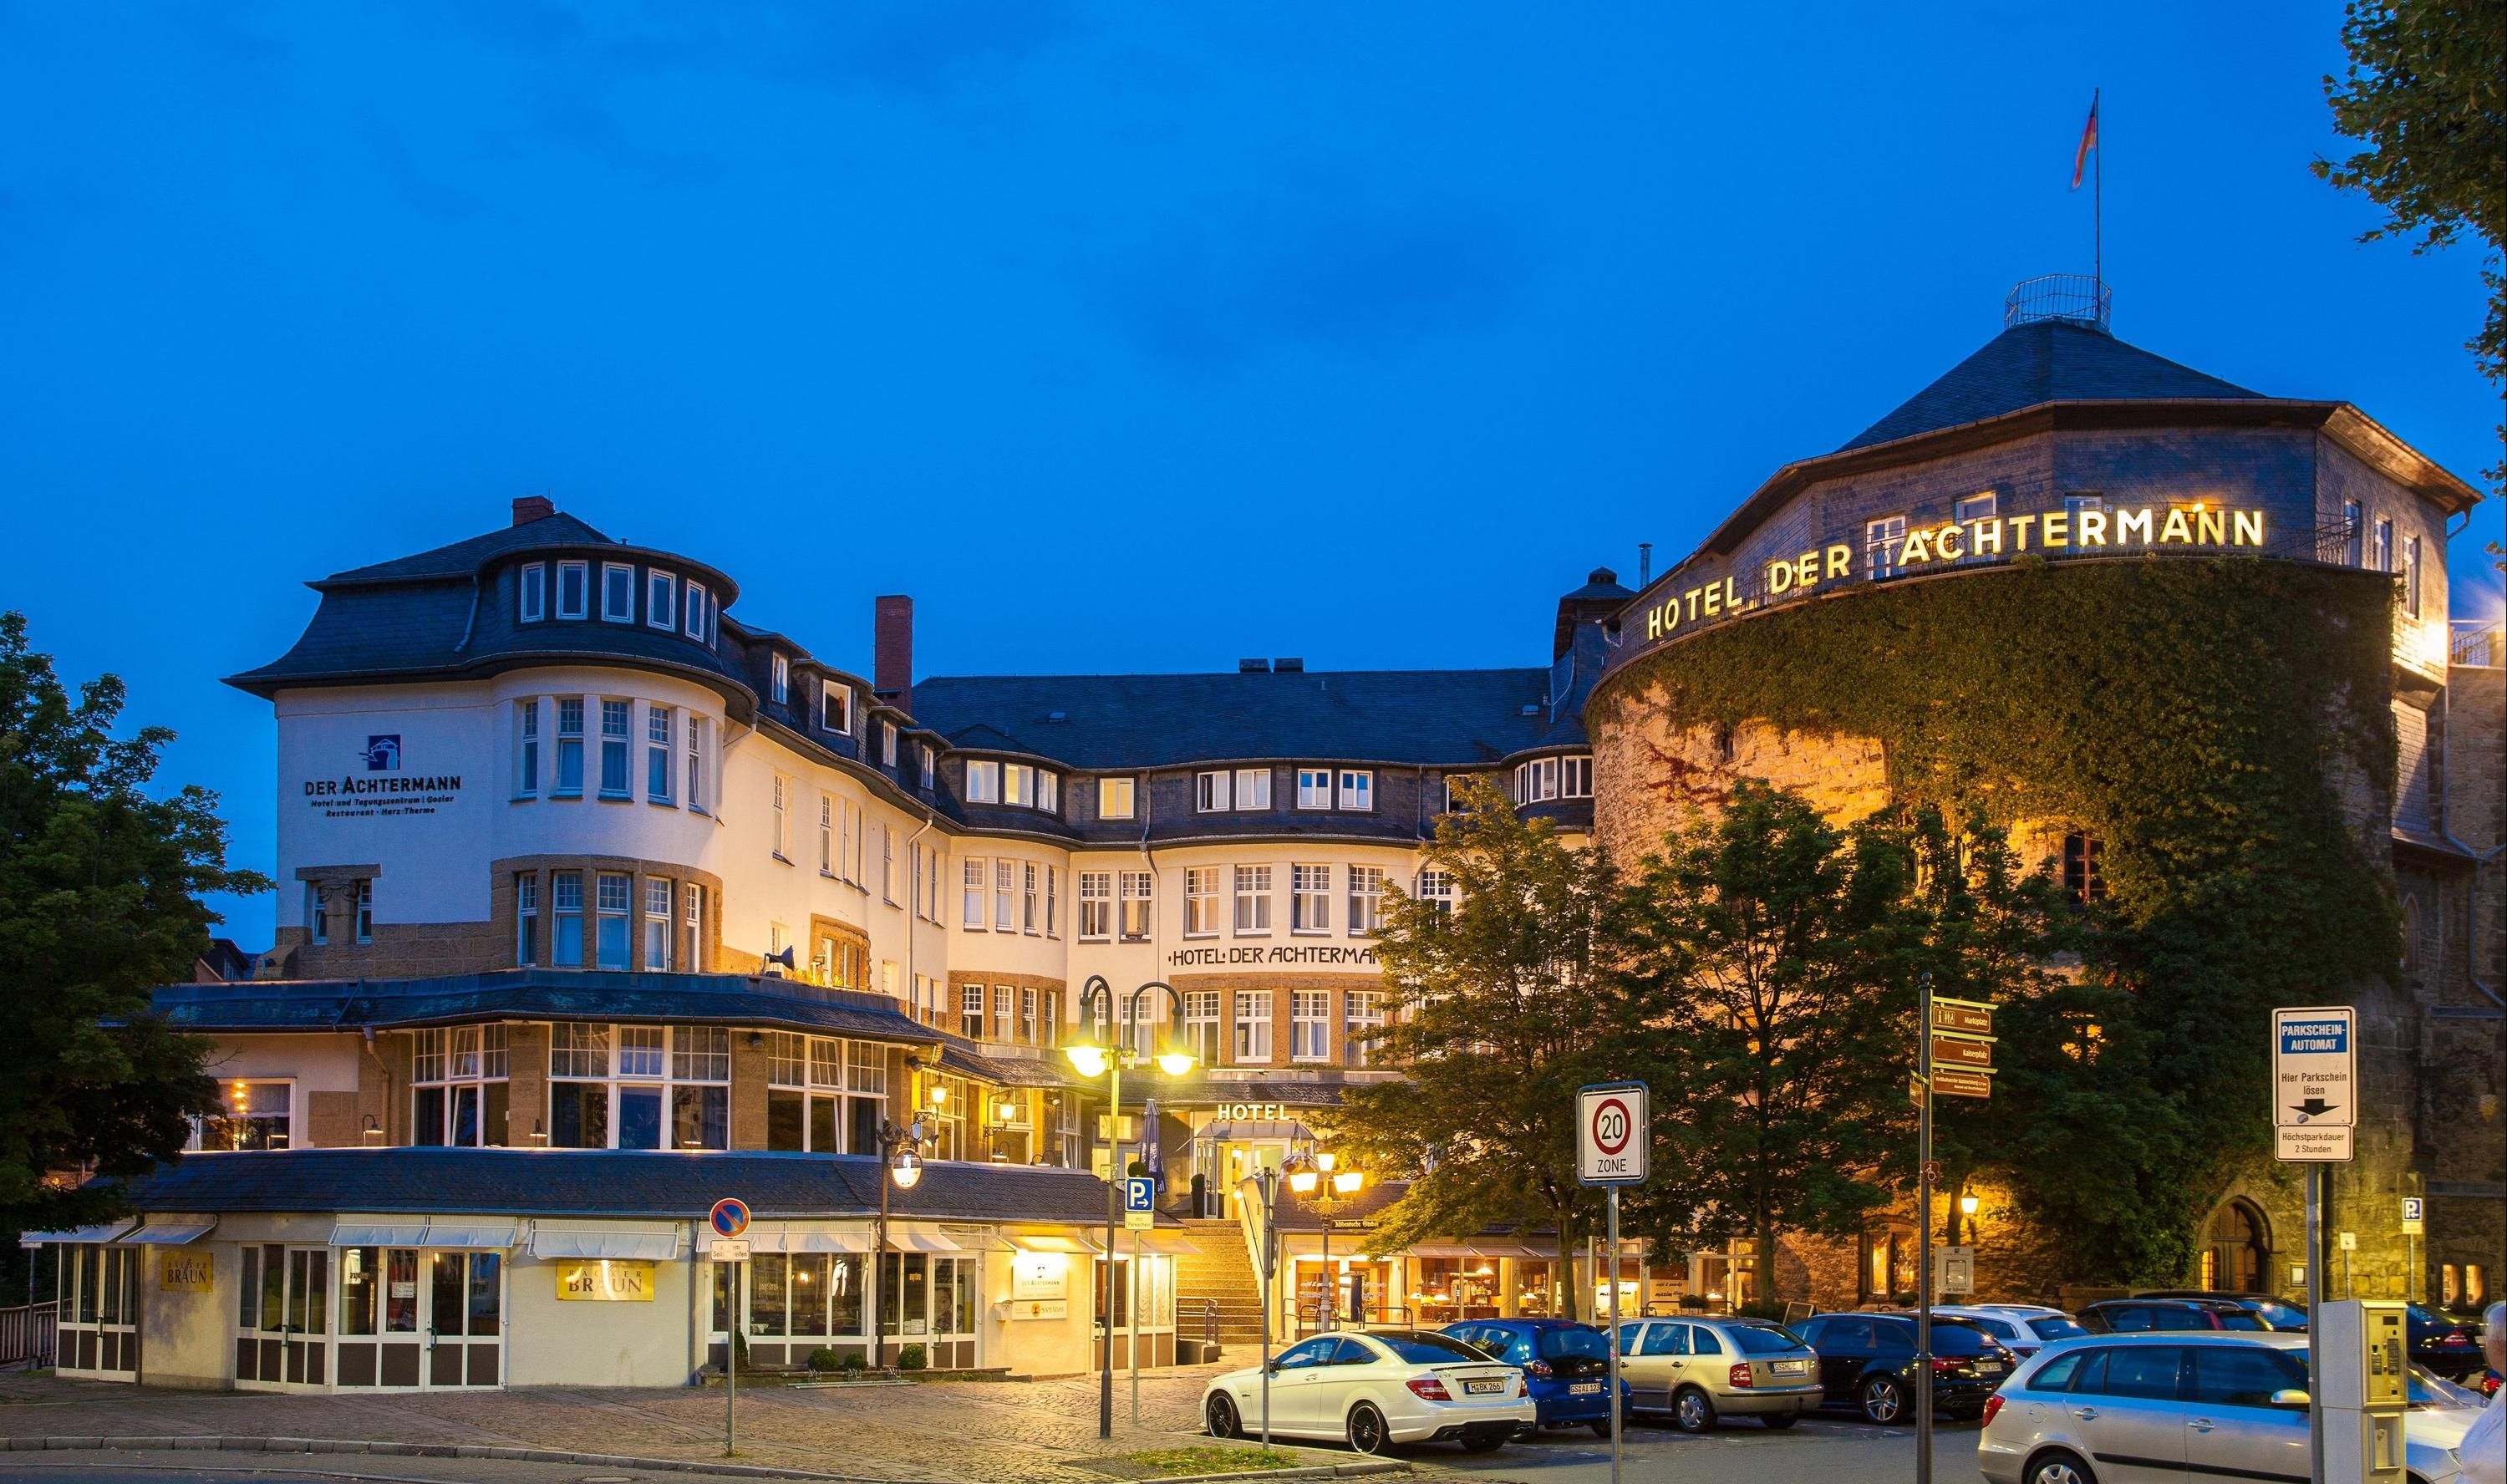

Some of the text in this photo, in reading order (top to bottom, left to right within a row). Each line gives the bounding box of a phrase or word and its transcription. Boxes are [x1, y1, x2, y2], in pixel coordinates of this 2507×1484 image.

[1647, 506, 2264, 640] HOTEL DER ACHTERMANN
[305, 775, 461, 796] DER ACHTERMANN
[312, 799, 333, 807] Hotel
[355, 797, 419, 807] Tagungszentrum
[427, 795, 455, 804] Goslar
[326, 809, 374, 817] Restaurant
[1229, 948, 1264, 963] DER
[1269, 947, 1381, 964] ACHTERMA
[1965, 1016, 1987, 1026] Marktplatz
[2281, 1024, 2346, 1036] PARKSCHEIN-
[2291, 1039, 2337, 1050] AUTOMAT
[1962, 1049, 1987, 1059] Kaiserpfalz
[2281, 1072, 2347, 1082] Hier Parkschein
[2303, 1086, 2325, 1095] lösen
[1218, 1104, 1290, 1121] HOTEL
[1601, 1114, 1623, 1140] 20
[2282, 1132, 2344, 1141] Höchstparkdauer
[2295, 1145, 2332, 1153] 2 Stunden
[1598, 1159, 1626, 1172] ZONE
[1130, 1182, 1146, 1207] P
[168, 1269, 206, 1283] BRAUN
